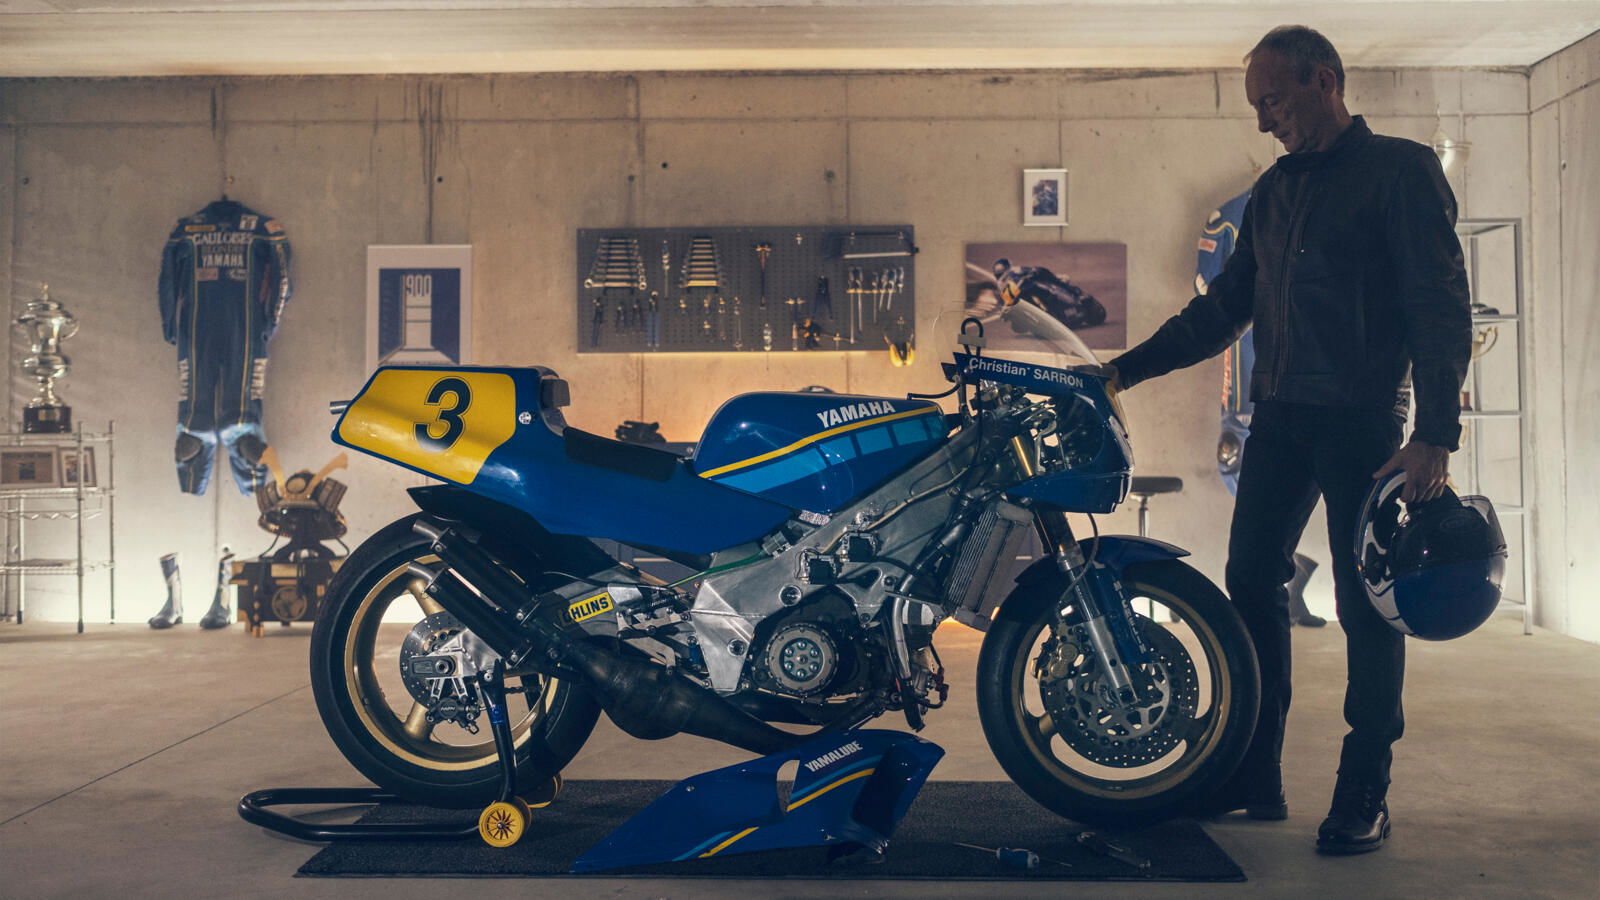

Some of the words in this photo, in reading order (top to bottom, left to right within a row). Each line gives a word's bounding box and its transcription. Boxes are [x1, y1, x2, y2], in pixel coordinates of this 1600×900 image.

[202, 254, 244, 267] YAMAHA
[968, 357, 1028, 377] Christian
[1033, 368, 1084, 388] SARRON
[413, 375, 473, 454] 3
[816, 400, 896, 428] YAMAHA
[804, 741, 863, 772] YAMALUBE
